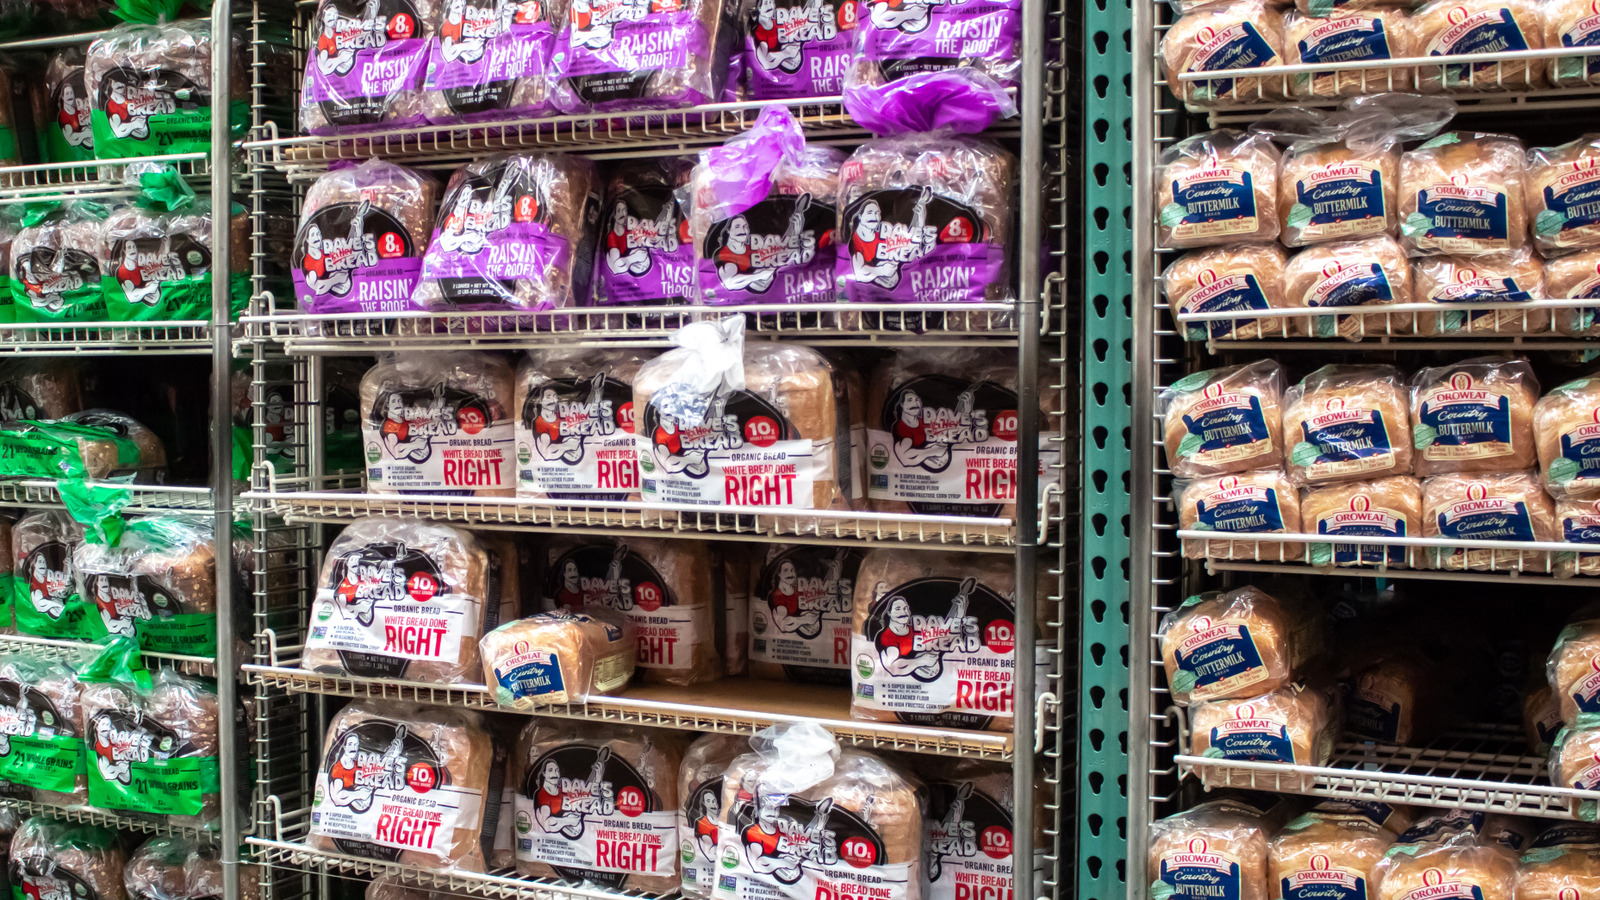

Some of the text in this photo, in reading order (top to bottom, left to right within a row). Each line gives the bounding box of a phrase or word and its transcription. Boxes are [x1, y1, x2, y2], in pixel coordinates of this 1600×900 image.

[776, 4, 836, 24] DAVE'S
[776, 24, 837, 44] BREAD
[936, 16, 1009, 39] RAISIN'
[1312, 17, 1362, 38] OROWEAT
[1442, 13, 1489, 44] OROWEAT
[335, 33, 387, 49] BREAD
[935, 39, 957, 54] THE
[962, 38, 999, 54] ROOF!
[1195, 29, 1233, 62] OROWEAT
[1316, 35, 1365, 56] Country
[641, 52, 673, 67] ROOF!
[812, 78, 834, 93] THE
[127, 100, 176, 117] BREAD
[1311, 167, 1361, 180] OROWEAT
[1186, 186, 1233, 200] Country
[1313, 186, 1362, 200] Country
[1436, 186, 1484, 198] OROWEAT
[1187, 197, 1240, 214] BUTTERMILK
[1314, 196, 1368, 215] BUTTERMILK
[1435, 203, 1485, 215] Country
[626, 215, 677, 238] DAVE'S
[1435, 215, 1490, 230] BUTTERMILK
[880, 221, 938, 243] DAVE'S
[322, 234, 376, 254] DAVE'S
[626, 234, 678, 252] BREAD
[750, 230, 816, 251] DAVE'S
[137, 253, 180, 268] DAVE'S
[750, 250, 816, 269] BREAD
[876, 243, 937, 263] BREAD
[324, 251, 378, 272] BREAD
[505, 262, 534, 277] ROOF!
[140, 268, 186, 282] BREAD
[911, 266, 976, 292] RAISIN'
[359, 278, 412, 301] RAISIN'
[1191, 277, 1235, 303] OROWEAT
[1437, 392, 1487, 402] OROWEAT
[403, 406, 454, 422] DAVE'S
[558, 401, 614, 418] DAVE'S
[923, 408, 988, 426] DAVE'S
[1313, 410, 1361, 425] OROWEAT
[1438, 410, 1488, 421] Country
[408, 421, 457, 436] BREAD
[559, 419, 616, 436] BREAD
[1201, 413, 1244, 428] Country
[1438, 421, 1494, 436] BUTTERMILK
[925, 429, 990, 444] BREAD
[1203, 422, 1252, 442] BUTTERMILK
[604, 439, 630, 447] ORGANIC
[680, 432, 744, 450] BREAD
[443, 449, 502, 458] WHITE BREAD DONE
[596, 450, 617, 459] WHITE
[732, 452, 786, 461] ORGANIC BREAD
[976, 446, 1007, 454] ORGANIC
[722, 464, 796, 475] WHITE BREAD DONE
[966, 458, 990, 468] WHITE
[443, 459, 503, 486] RIGHT
[725, 474, 796, 505] RIGHT
[1214, 505, 1259, 518] Country
[1453, 500, 1505, 514] OROWEAT
[1215, 514, 1267, 530] BUTTERMILK
[1336, 513, 1386, 522] OROWEAT
[1457, 517, 1508, 532] Country
[359, 564, 406, 582] DAVE'S
[356, 583, 406, 601] BREAD
[580, 576, 631, 595] DAVE'S
[798, 577, 852, 595] DAVE'S
[394, 605, 440, 615] ORGANIC BREAD
[798, 597, 852, 613] BREAD
[385, 616, 447, 628] WHITE DONE
[649, 617, 668, 625] BREAD
[912, 615, 979, 635] DAVE'S
[179, 635, 208, 644] GRAINS
[659, 628, 677, 637] DONE
[1184, 626, 1228, 648] OROWEAT
[384, 625, 447, 657] RIGHT
[913, 636, 980, 653] BREAD
[505, 652, 543, 668] OROWEAT
[1191, 643, 1235, 665] Country
[967, 658, 998, 667] ORGANIC
[1195, 652, 1245, 678] BUTTERMILK
[958, 669, 1010, 681] WHITE BREAD
[1224, 720, 1270, 730] OROWEAT
[1225, 738, 1272, 748] Country
[14, 751, 73, 769] 21 WHOLE GRAINS
[357, 751, 409, 772] DAVE'S
[135, 779, 198, 794] 21 GRAINS
[355, 769, 405, 791] BREAD
[560, 778, 614, 798] DAVE'S
[391, 795, 417, 804] ORGANIC
[562, 796, 614, 816] BREAD
[382, 804, 442, 821] WHITE BREAD DONE
[376, 814, 441, 849] RIGHT
[604, 820, 652, 830] ORGANIC BREAD
[596, 830, 661, 844] WHITE BREAD DONE
[596, 840, 662, 872] RIGHT
[1174, 854, 1221, 865] OROWEAT
[965, 861, 994, 872] ORGANIC
[824, 869, 882, 883] ORGANIC BREAD
[955, 872, 1006, 887] WHITE BREAD
[1174, 871, 1220, 882] Country
[1297, 871, 1345, 881] OROWEAT
[841, 882, 891, 898] BREAD DONE
[1176, 883, 1225, 897] BUTTERMILK
[1298, 889, 1346, 899] Country
[1411, 884, 1460, 900] OROWEAT
